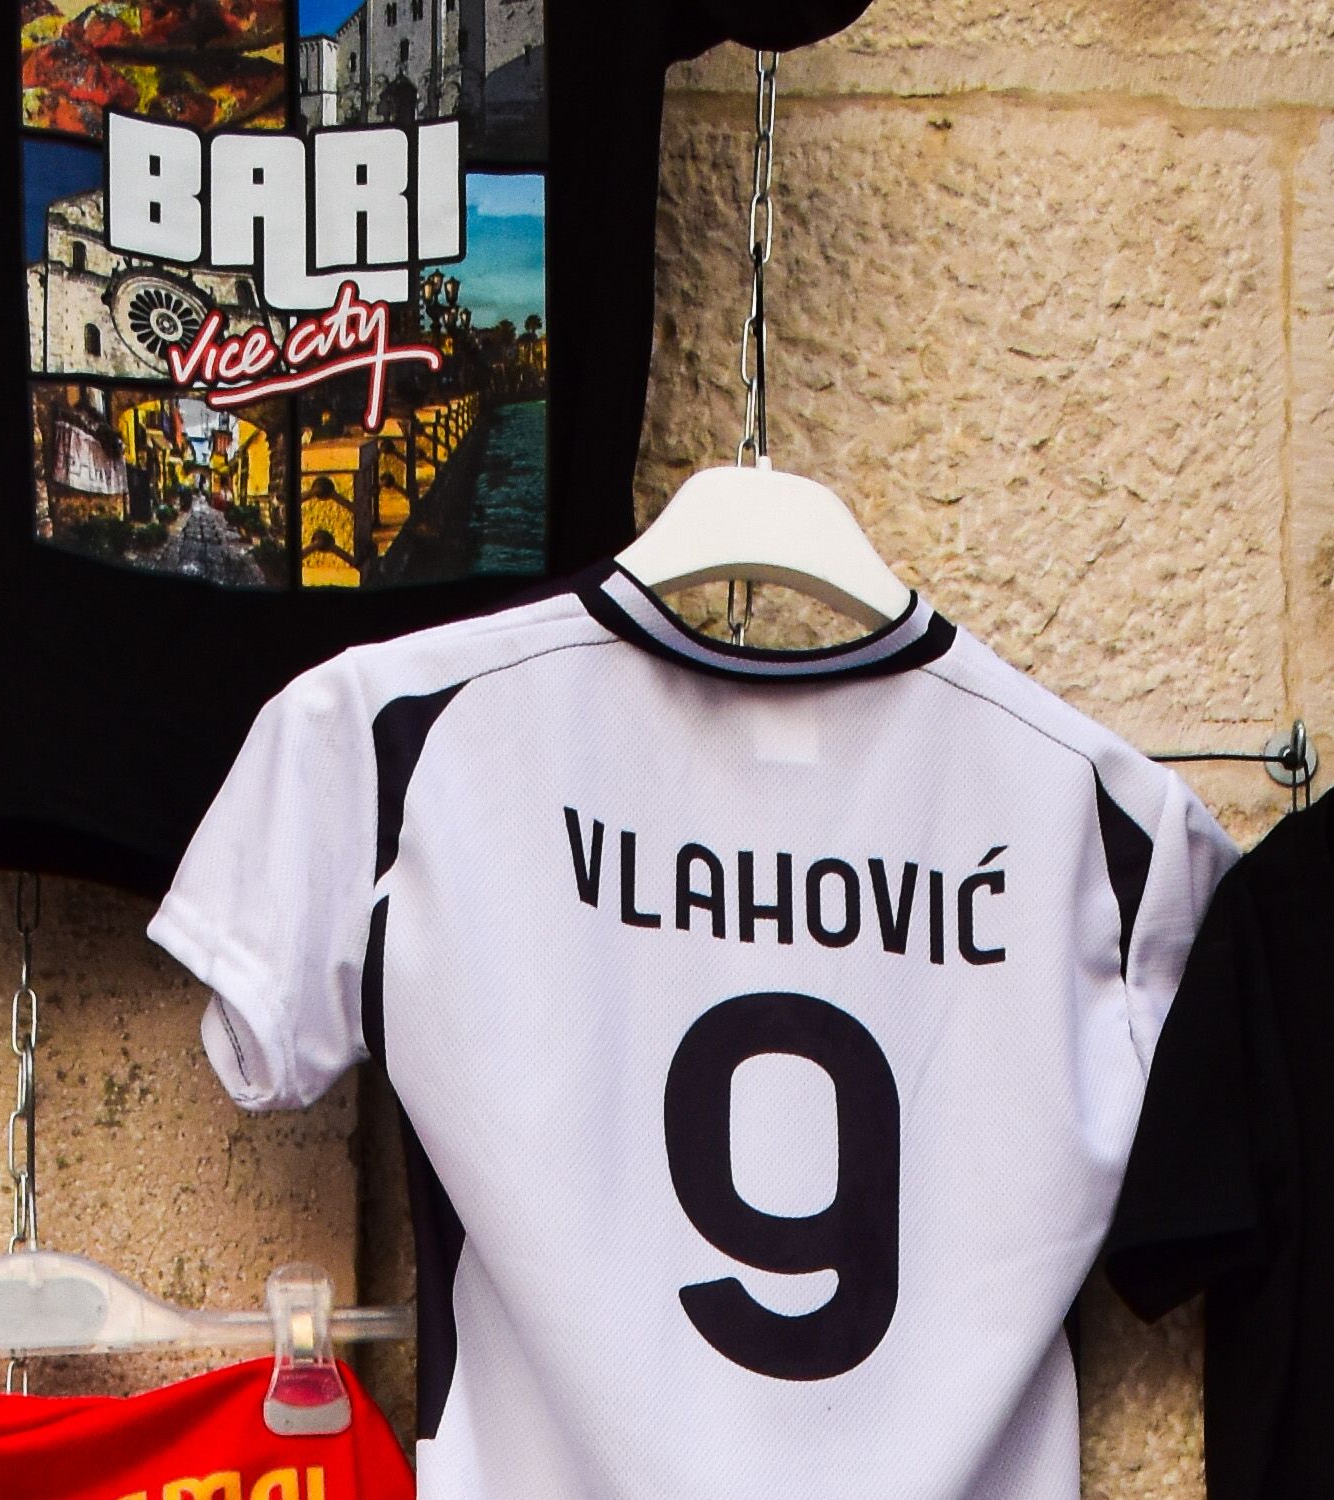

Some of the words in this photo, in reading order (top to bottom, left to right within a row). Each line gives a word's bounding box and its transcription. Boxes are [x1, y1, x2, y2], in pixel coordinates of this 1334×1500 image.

[108, 112, 464, 310] BARI
[169, 311, 275, 385] Vice
[563, 805, 1008, 967] VLAHOVIĆ
[664, 991, 902, 1382] 9
